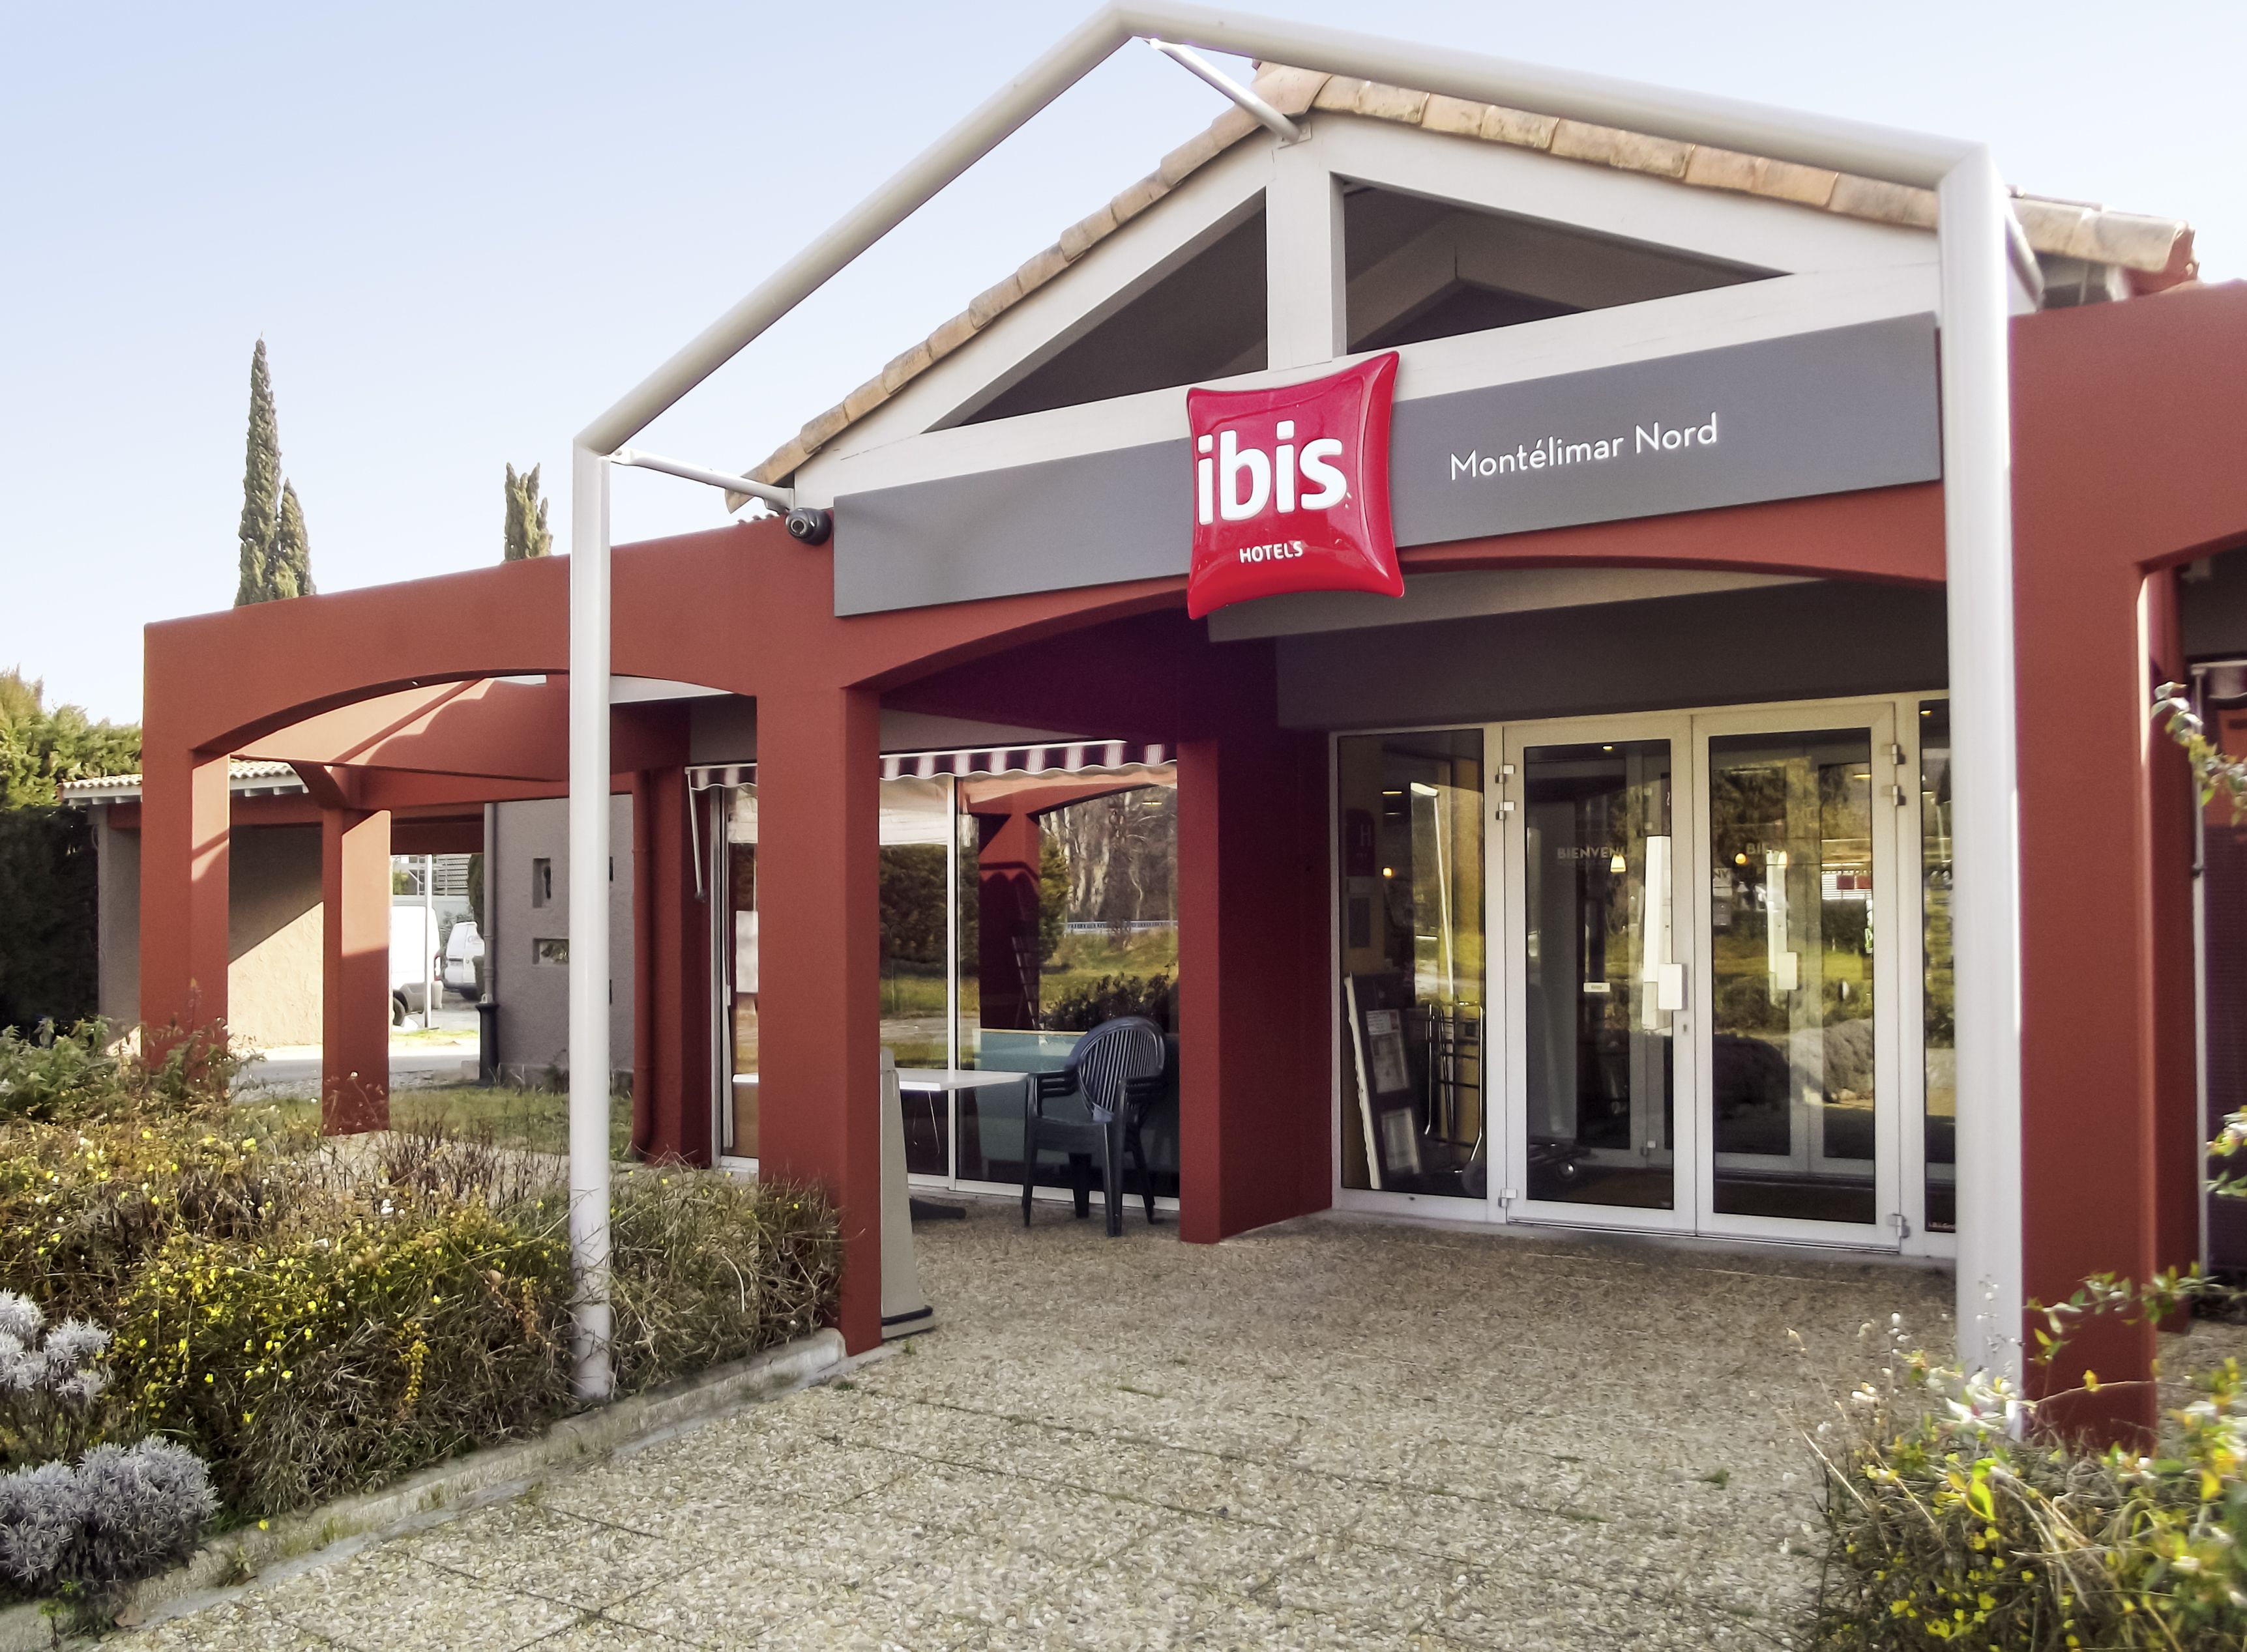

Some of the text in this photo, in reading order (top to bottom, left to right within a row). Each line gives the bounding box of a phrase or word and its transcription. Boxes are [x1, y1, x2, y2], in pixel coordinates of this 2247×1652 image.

[1197, 419, 1348, 526] ibis
[1450, 412, 1718, 482] Montélimar Nord
[1239, 541, 1304, 564] HOTELS
